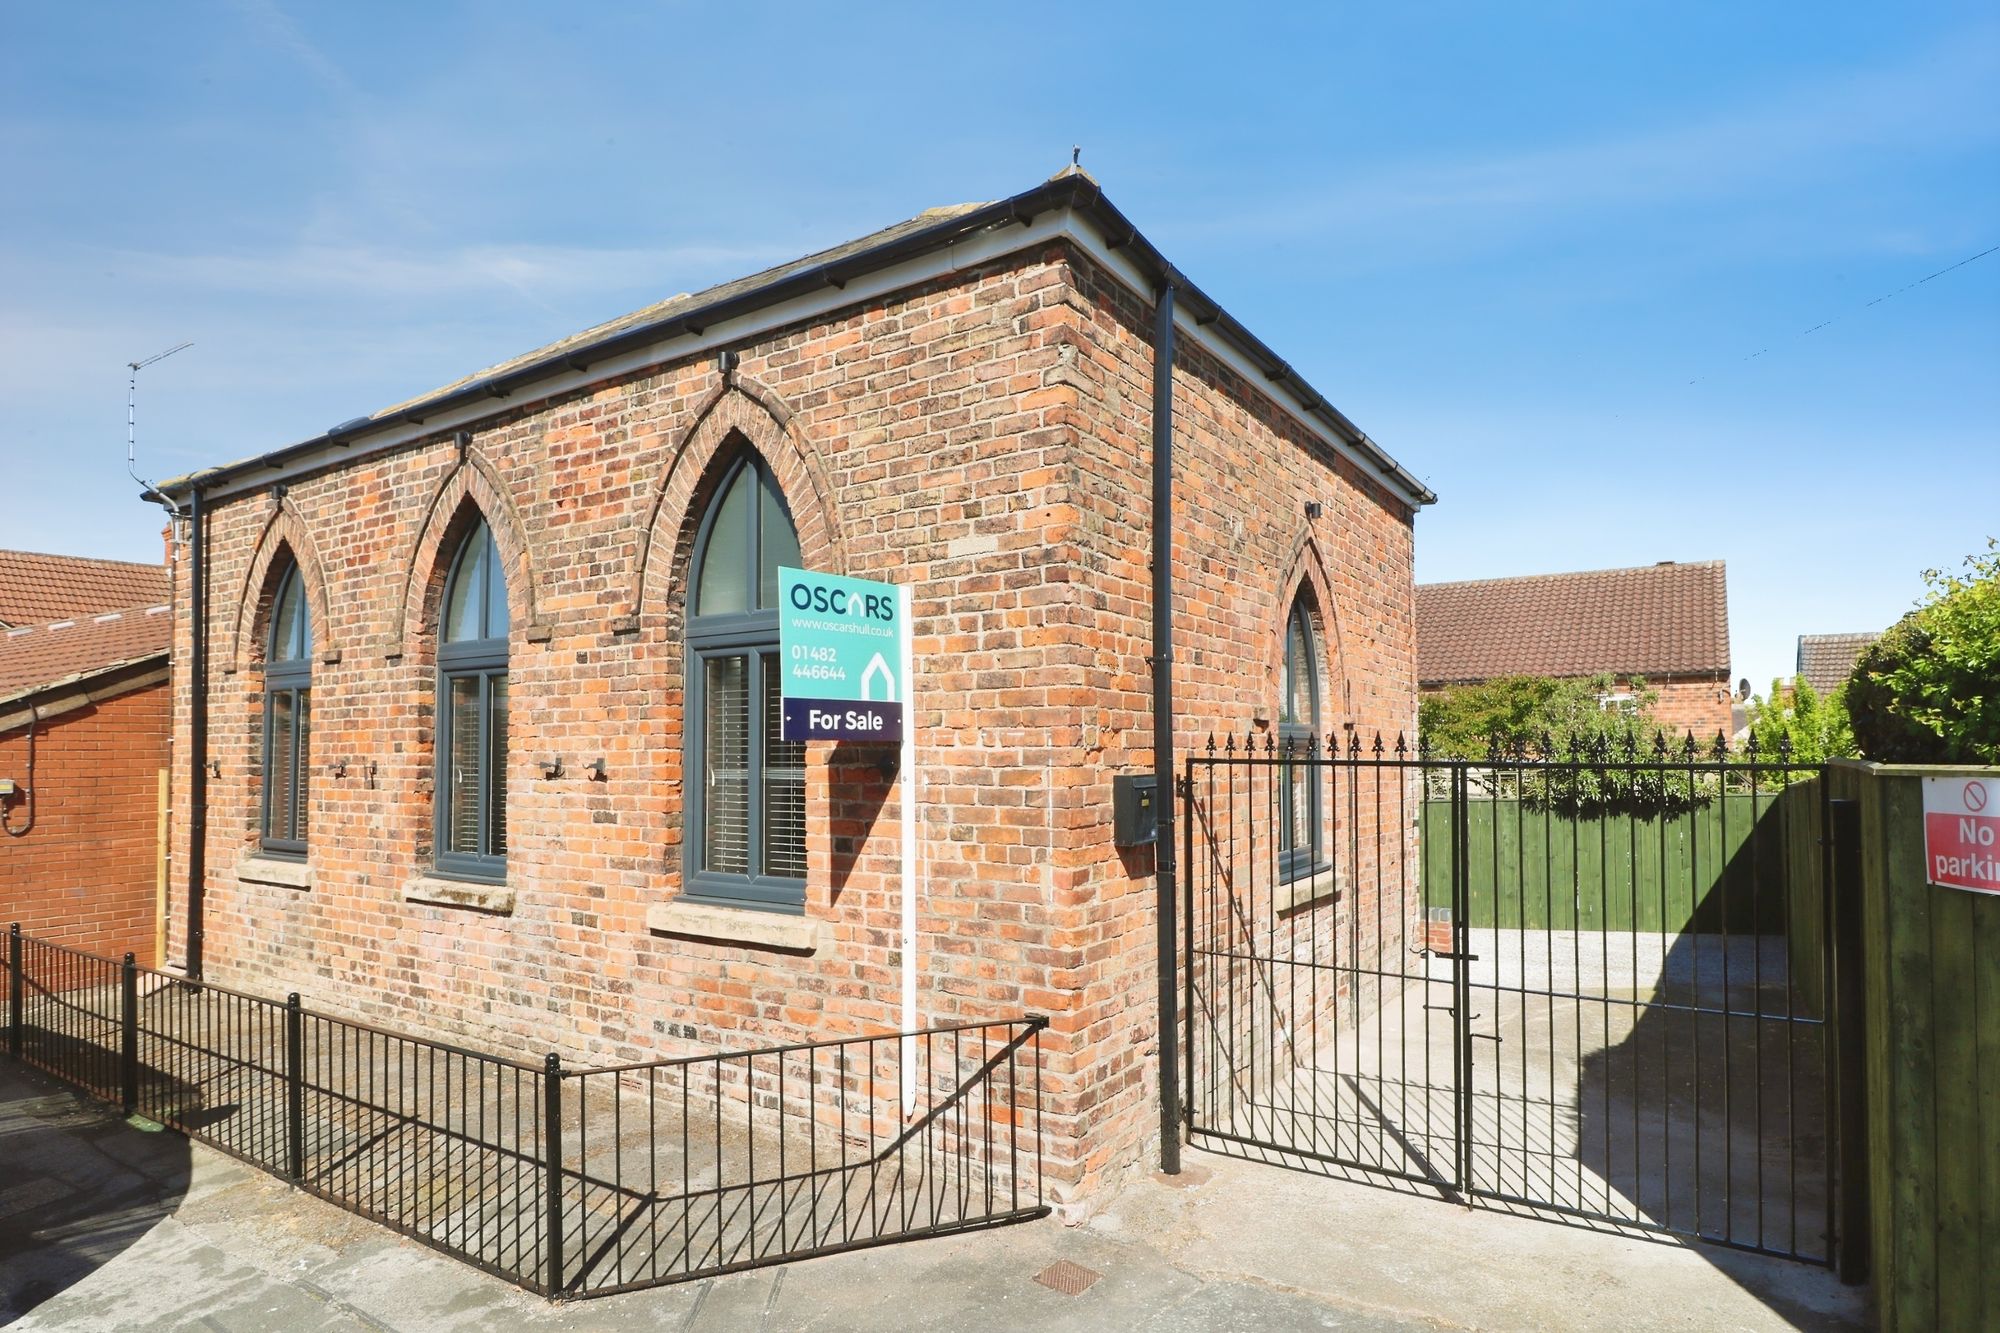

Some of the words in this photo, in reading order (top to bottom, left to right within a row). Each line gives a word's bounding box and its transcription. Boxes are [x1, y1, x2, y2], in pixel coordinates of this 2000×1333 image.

[791, 617, 894, 638] www.oscarshull.co.uk
[791, 645, 837, 662] 01482
[792, 663, 846, 681] 446644
[809, 709, 842, 730] For
[845, 711, 884, 731] Sale
[1959, 818, 1994, 846] No
